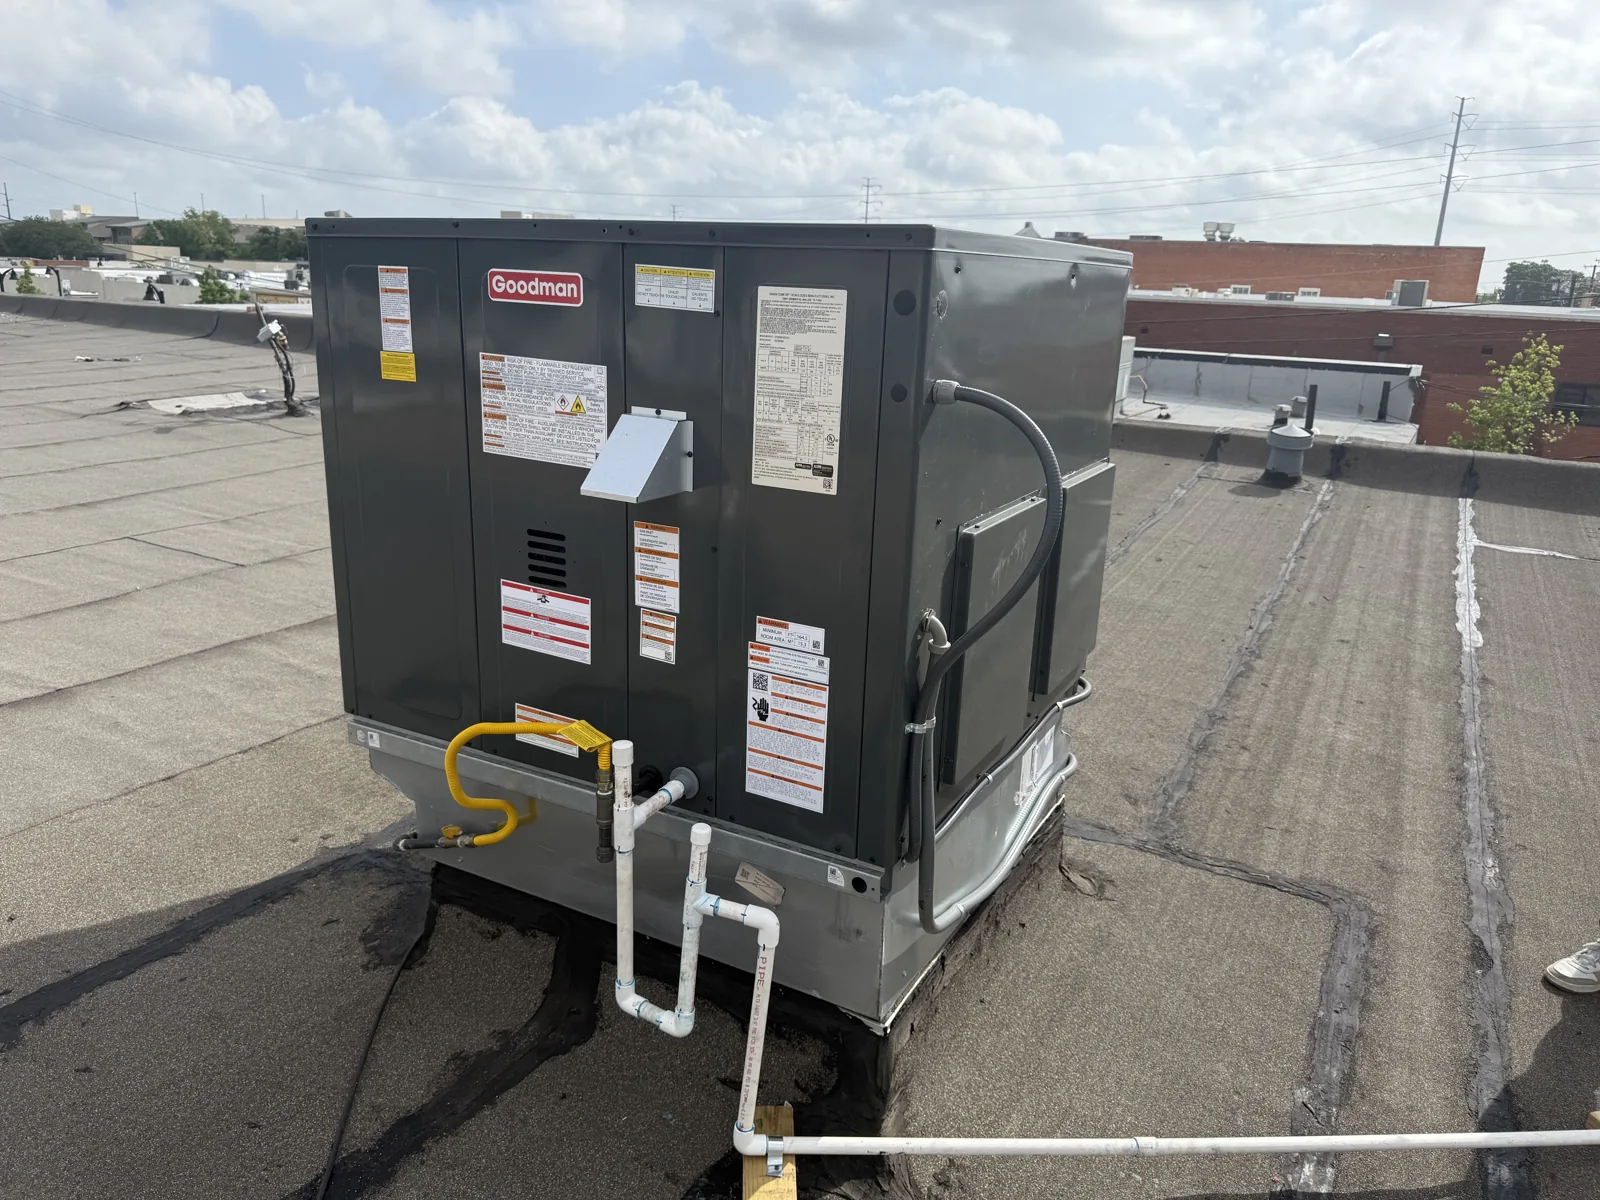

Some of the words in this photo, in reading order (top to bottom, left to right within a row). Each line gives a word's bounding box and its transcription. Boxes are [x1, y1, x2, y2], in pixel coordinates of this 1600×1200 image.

[491, 275, 578, 298] Goodman
[562, 364, 592, 372] REFRIGERANT
[546, 372, 577, 381] REFRIGERANT
[516, 393, 543, 401] ACCORDANCE
[507, 402, 535, 410] REFRIGERANT
[763, 627, 782, 635] MINIMUM
[757, 957, 767, 987] PIPE
